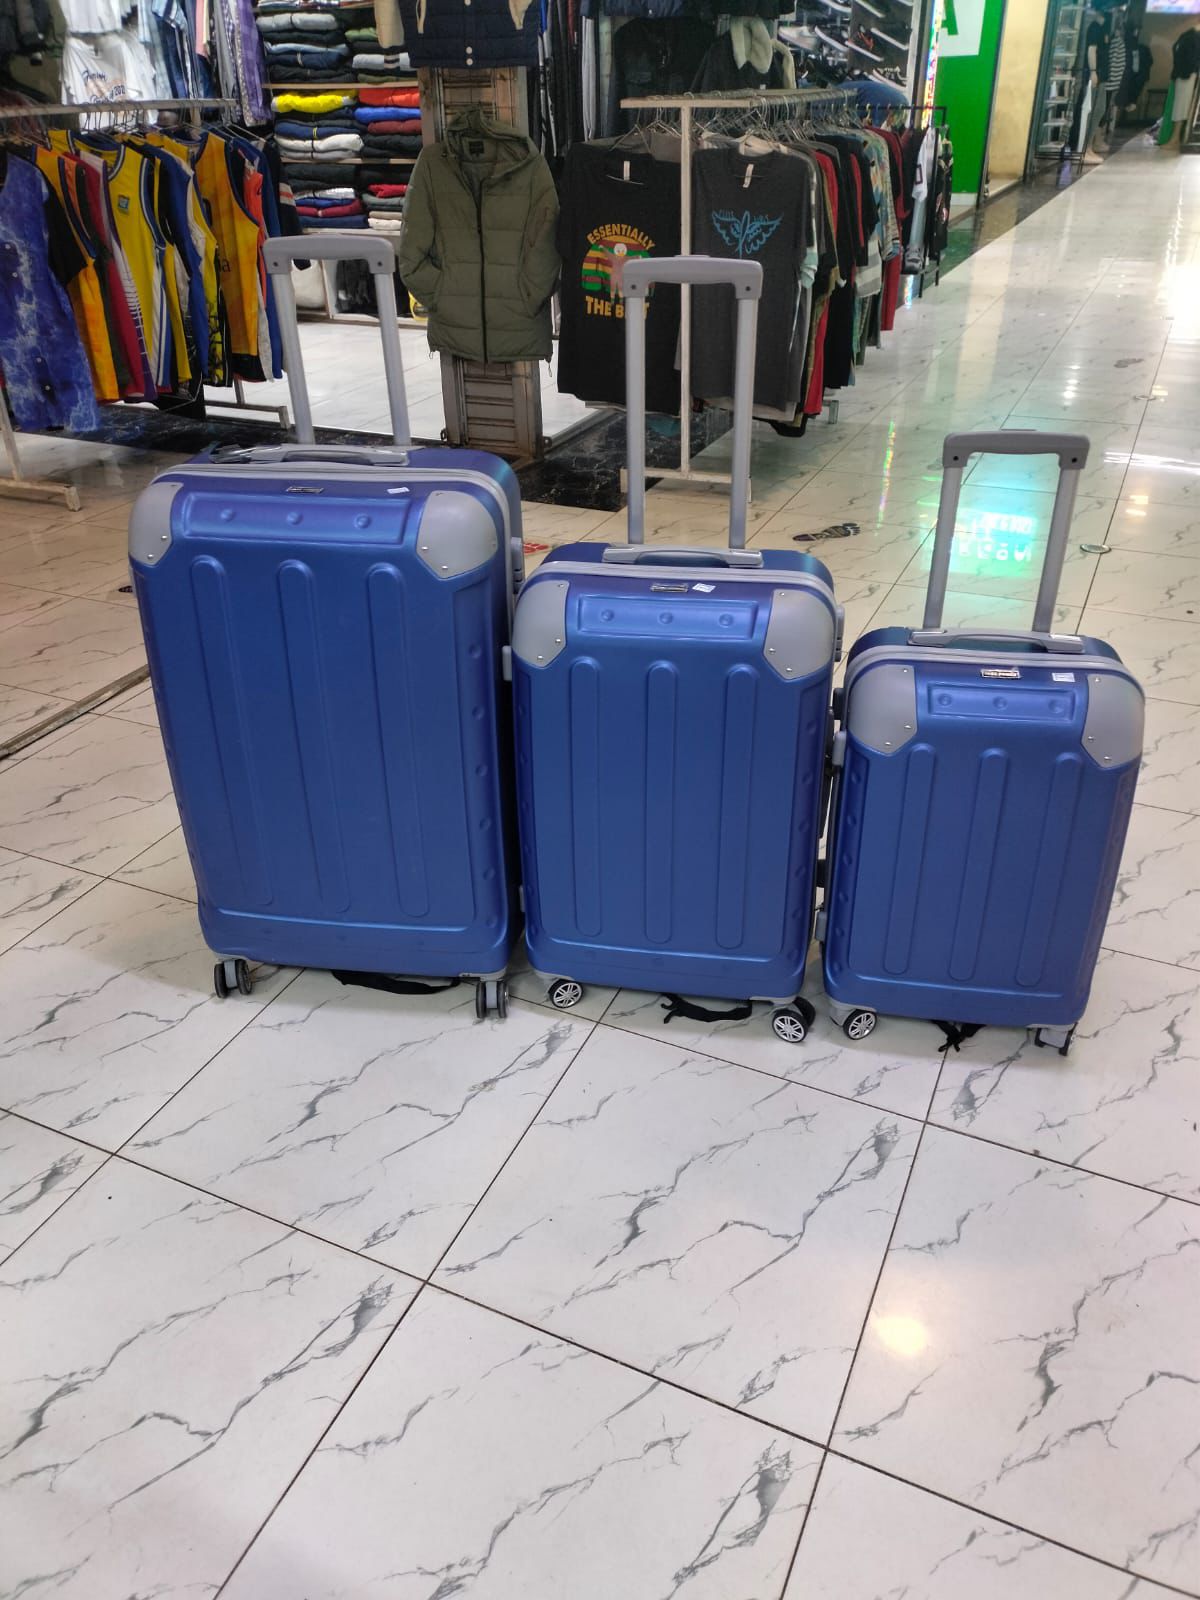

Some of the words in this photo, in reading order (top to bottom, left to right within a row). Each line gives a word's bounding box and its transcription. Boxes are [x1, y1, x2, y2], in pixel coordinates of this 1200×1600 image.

[586, 223, 656, 251] ESSENTIALLY
[585, 295, 612, 317] THE
[615, 301, 650, 321] BT
